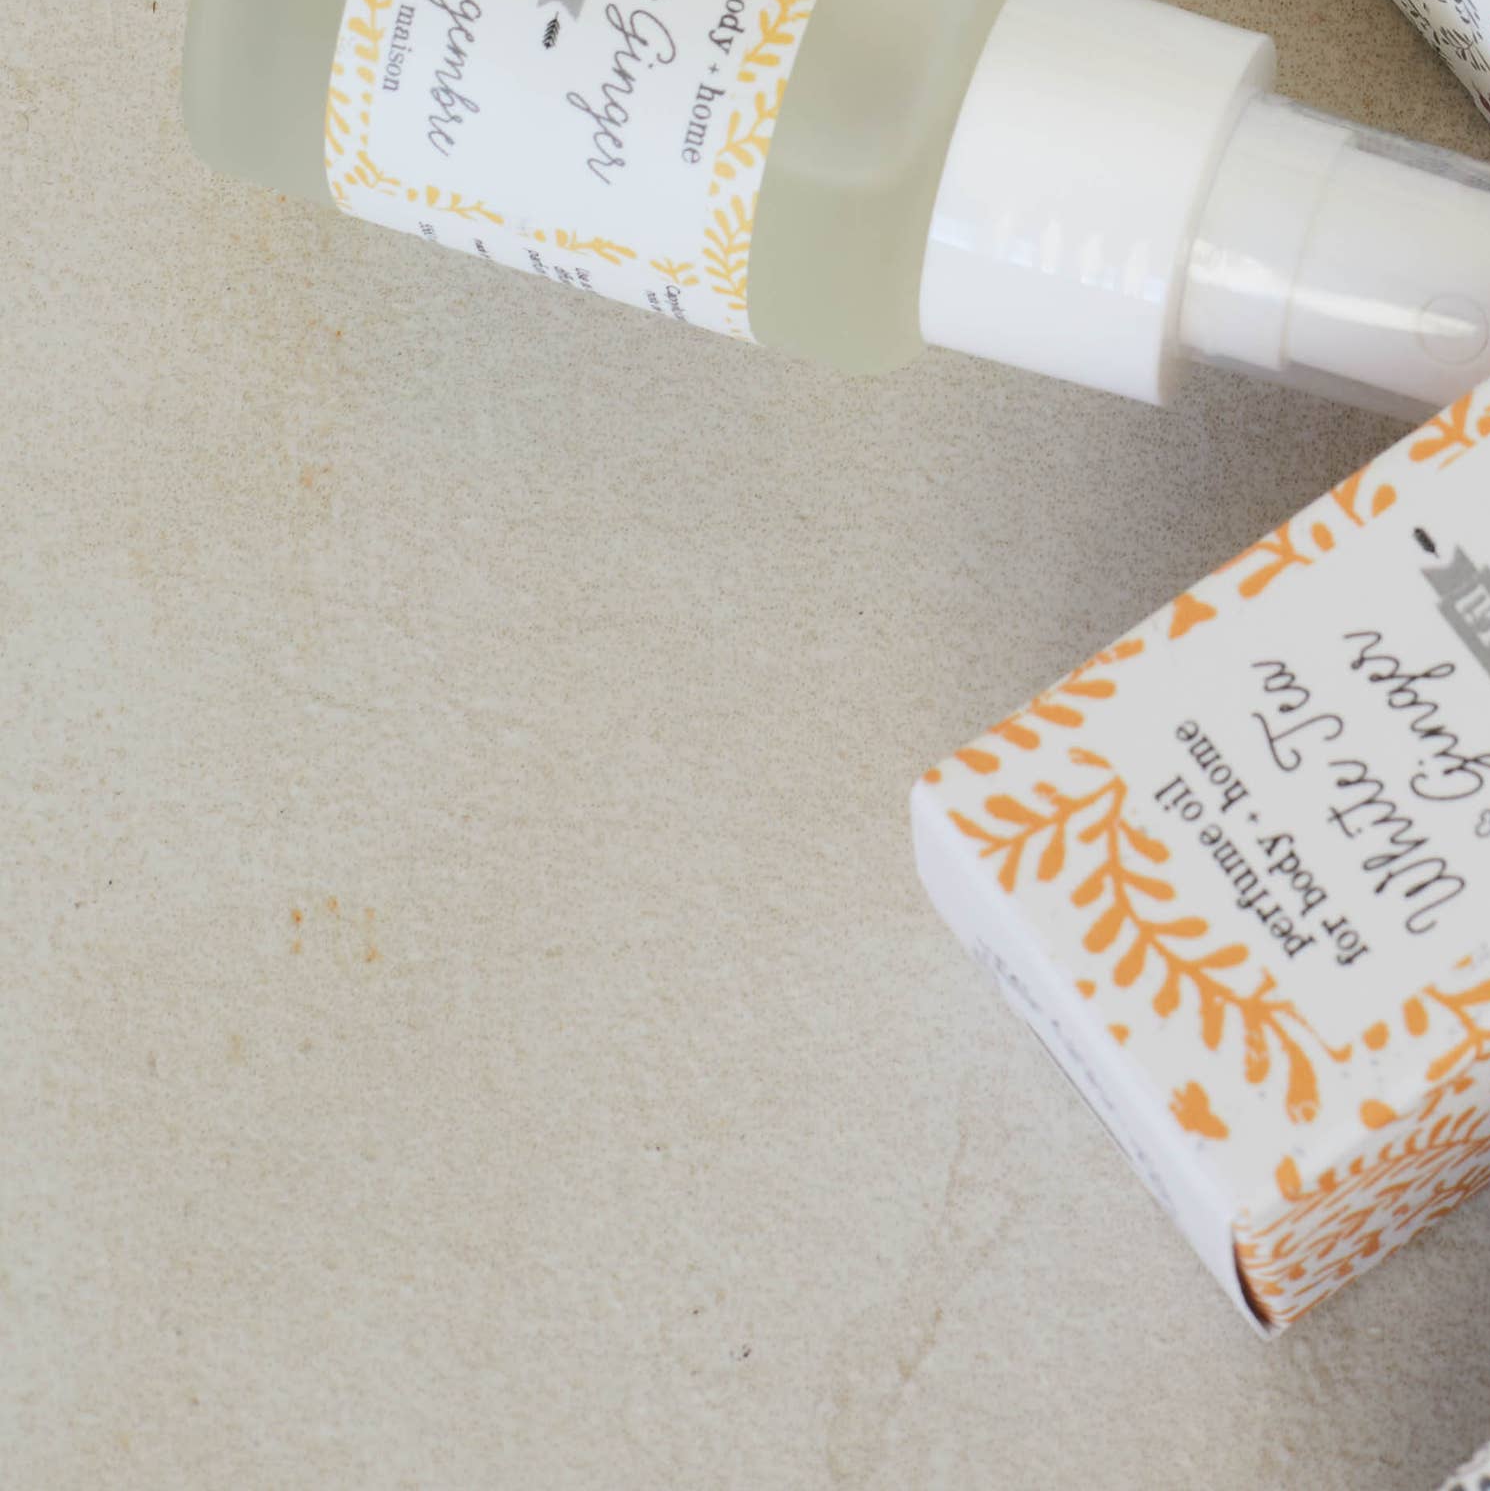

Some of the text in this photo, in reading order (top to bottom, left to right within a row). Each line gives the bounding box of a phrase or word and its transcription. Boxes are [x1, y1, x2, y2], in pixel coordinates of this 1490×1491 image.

[382, 3, 416, 92] maison
[565, 2, 677, 185] Ginger
[681, 82, 727, 164] home
[1153, 774, 1318, 960] perfume oil
[1175, 720, 1371, 967] for body home
[1251, 660, 1467, 936] White Tea
